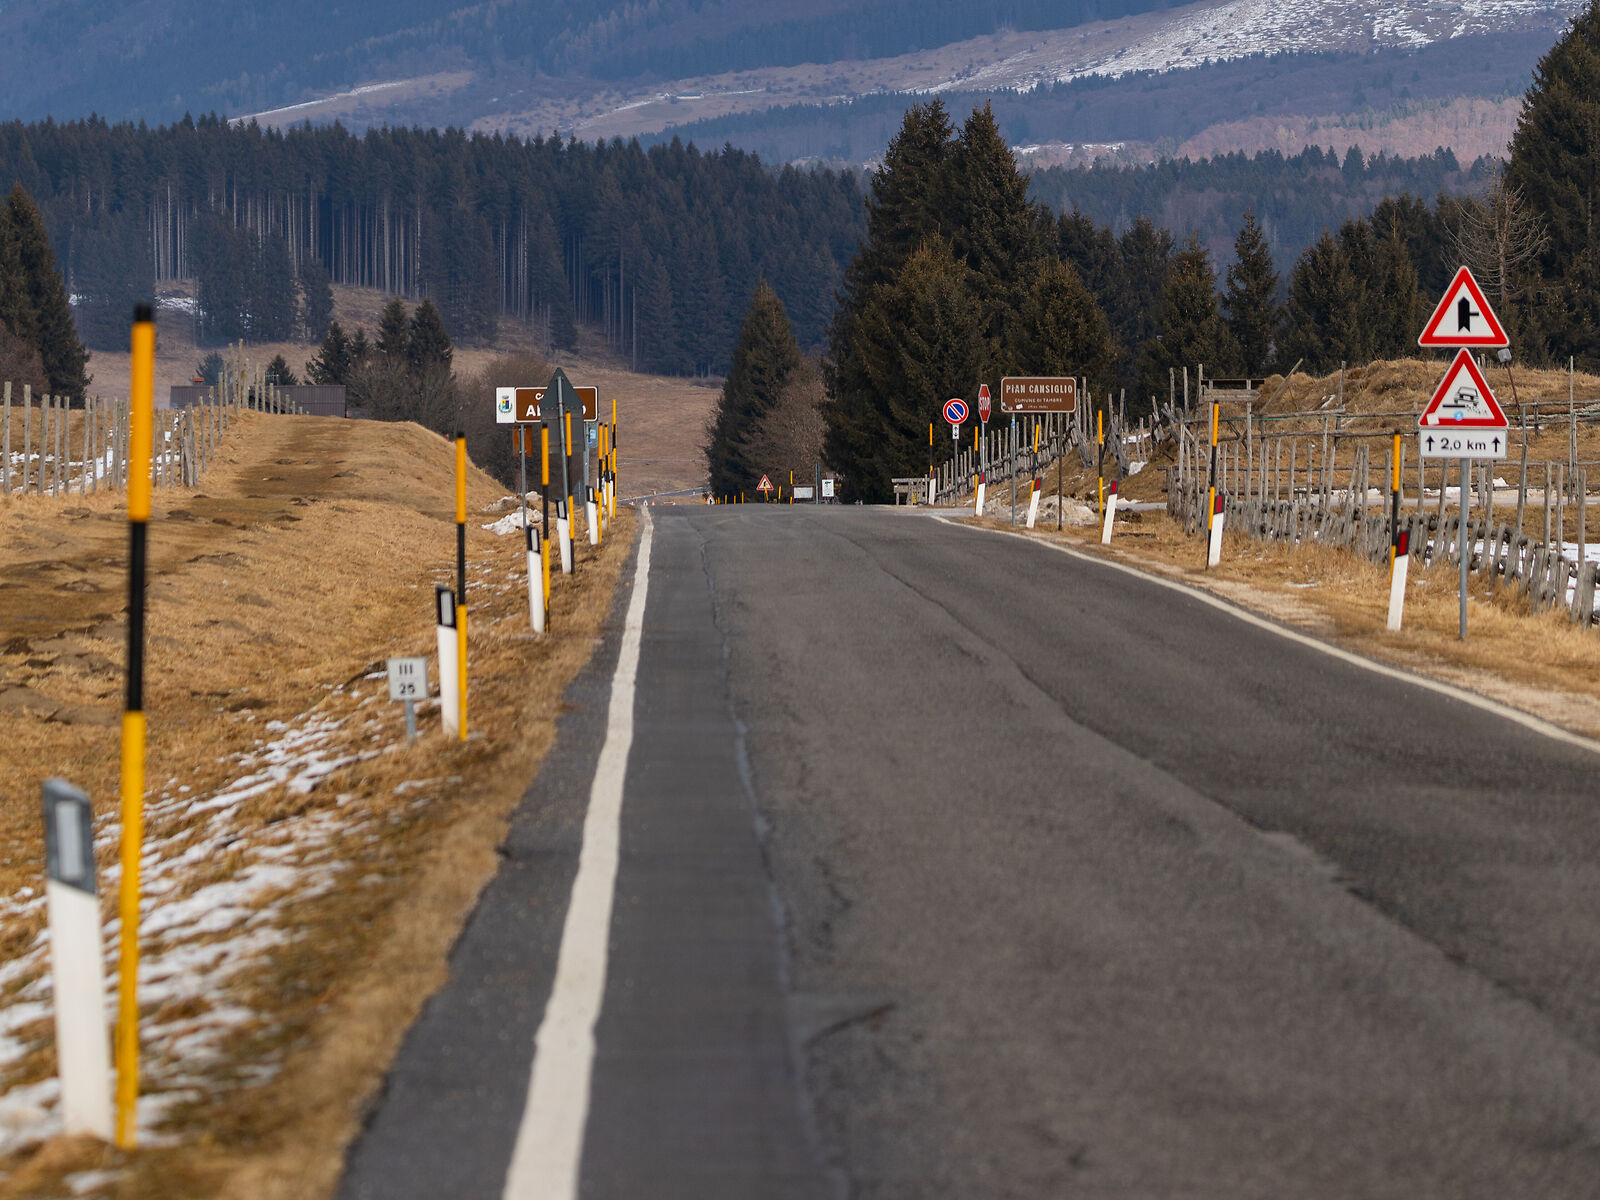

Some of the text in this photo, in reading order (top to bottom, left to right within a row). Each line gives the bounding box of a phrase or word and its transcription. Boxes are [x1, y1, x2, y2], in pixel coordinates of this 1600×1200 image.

[1029, 384, 1073, 394] CANSIGLIO
[979, 397, 990, 411] STOP
[1467, 439, 1486, 450] km
